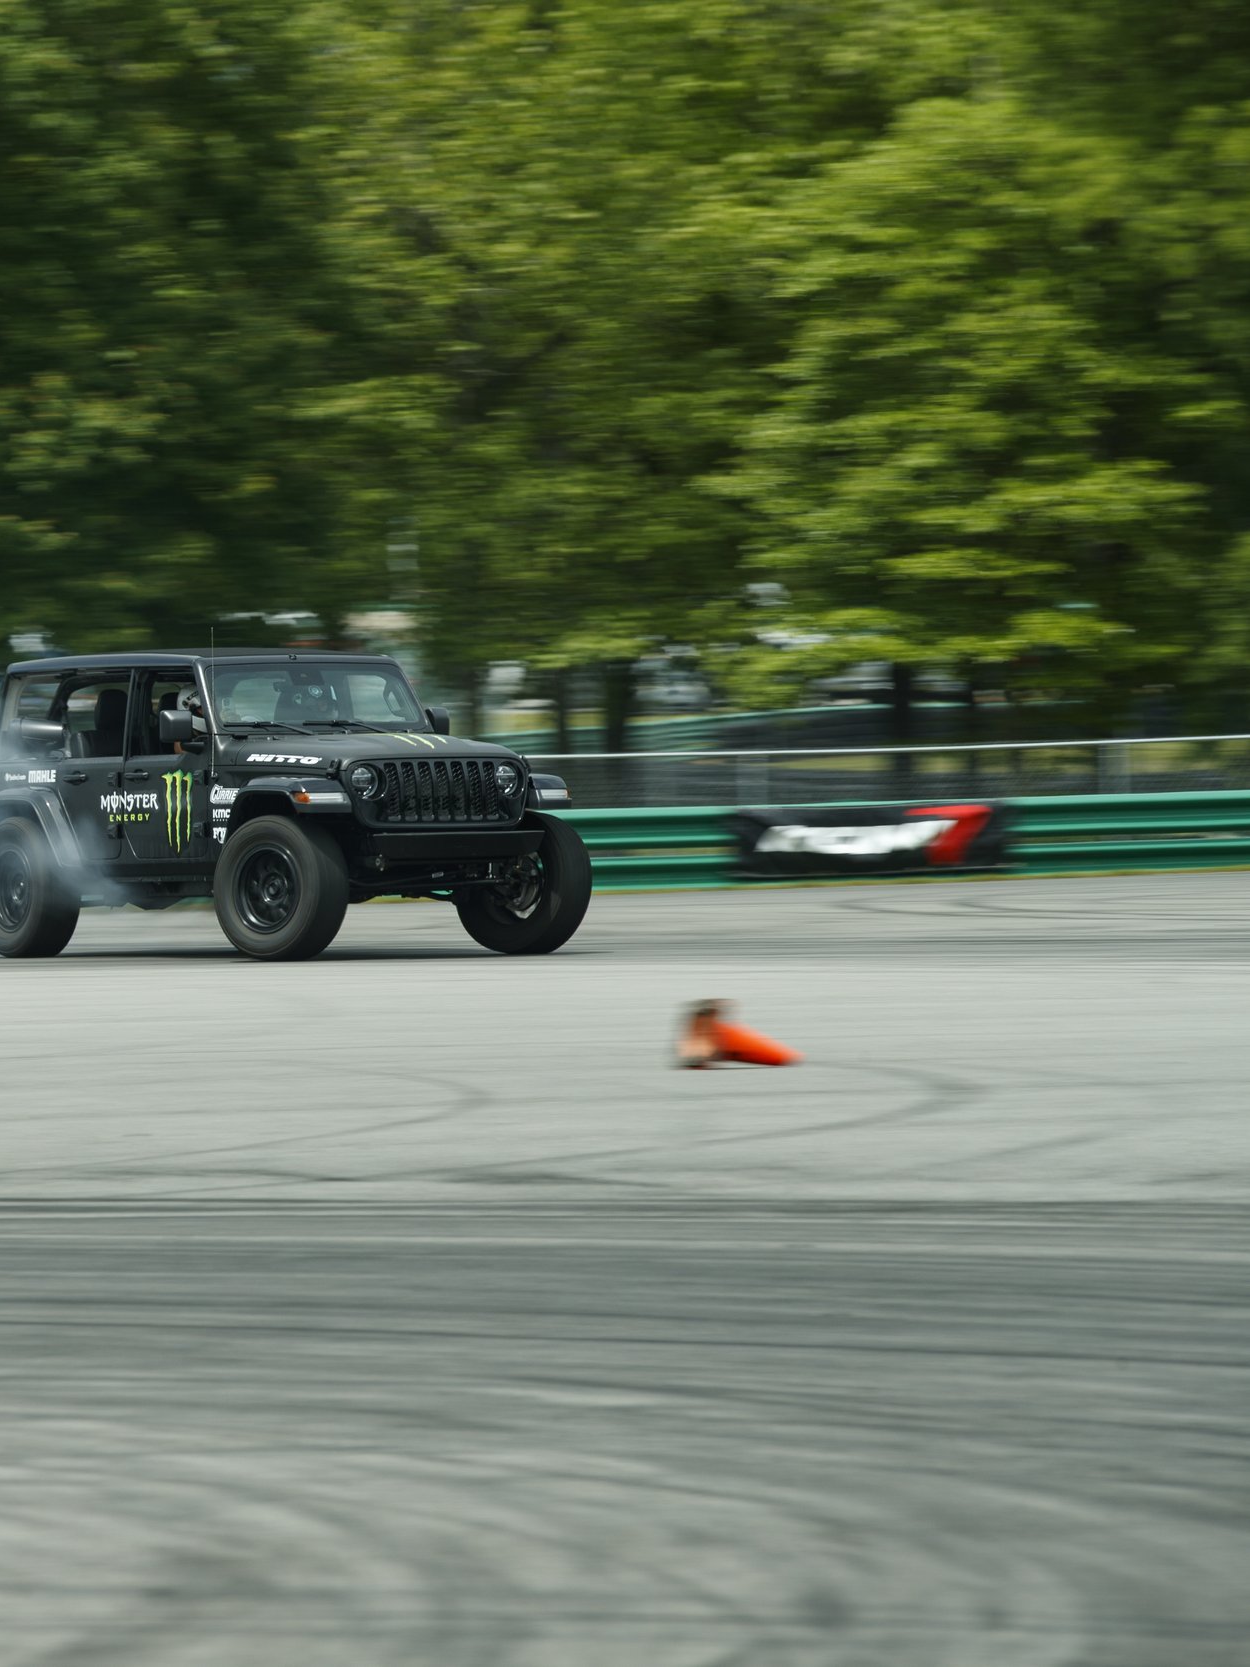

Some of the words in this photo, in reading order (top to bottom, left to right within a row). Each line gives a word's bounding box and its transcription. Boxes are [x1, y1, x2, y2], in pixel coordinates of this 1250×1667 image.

[246, 753, 323, 765] NITTO
[28, 769, 57, 783] MAHLE
[210, 784, 240, 804] CURRIE
[100, 790, 159, 813] MONSTER
[109, 813, 150, 822] ENERGY
[212, 808, 231, 819] KMC
